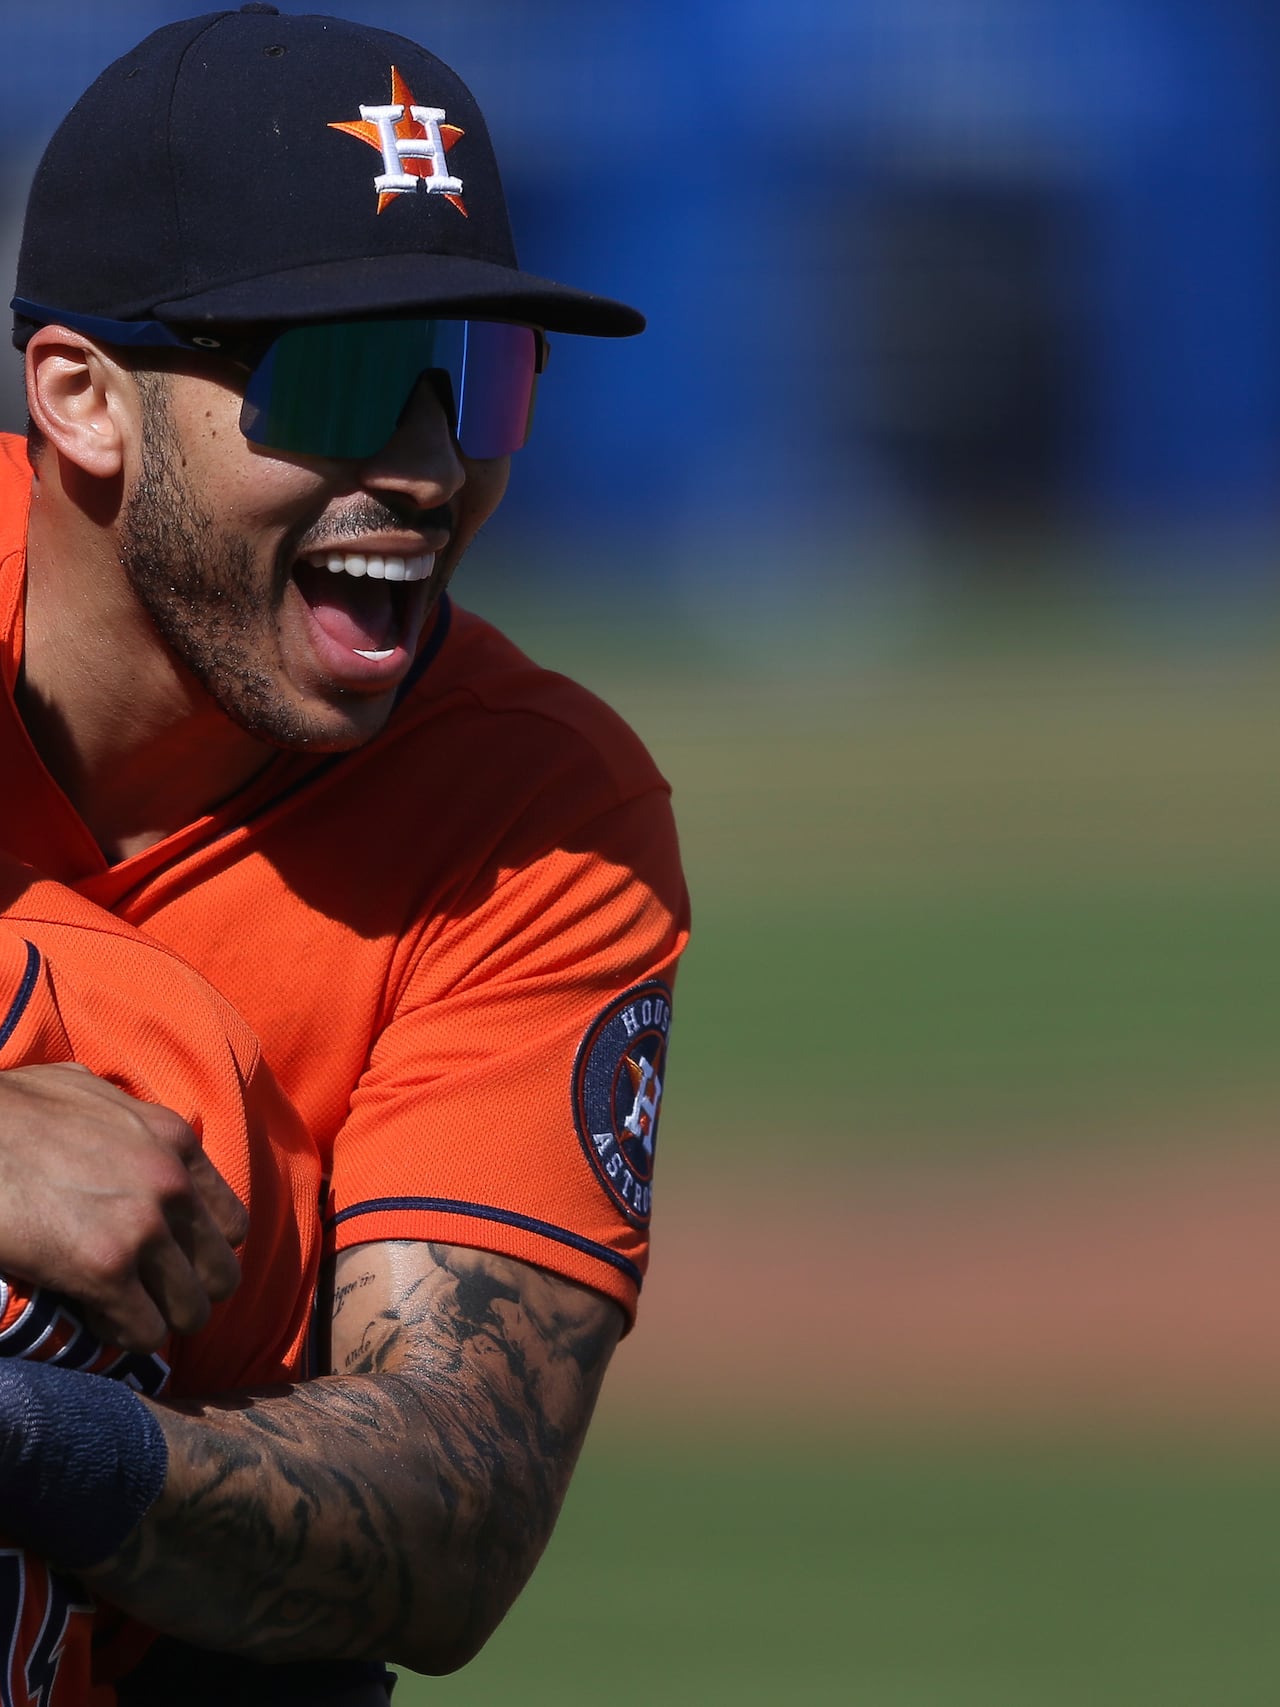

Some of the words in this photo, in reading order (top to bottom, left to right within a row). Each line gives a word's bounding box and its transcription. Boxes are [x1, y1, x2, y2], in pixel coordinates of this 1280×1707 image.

[358, 104, 463, 194] H
[621, 998, 670, 1037] HOUS
[592, 1132, 653, 1213] ASTRO
